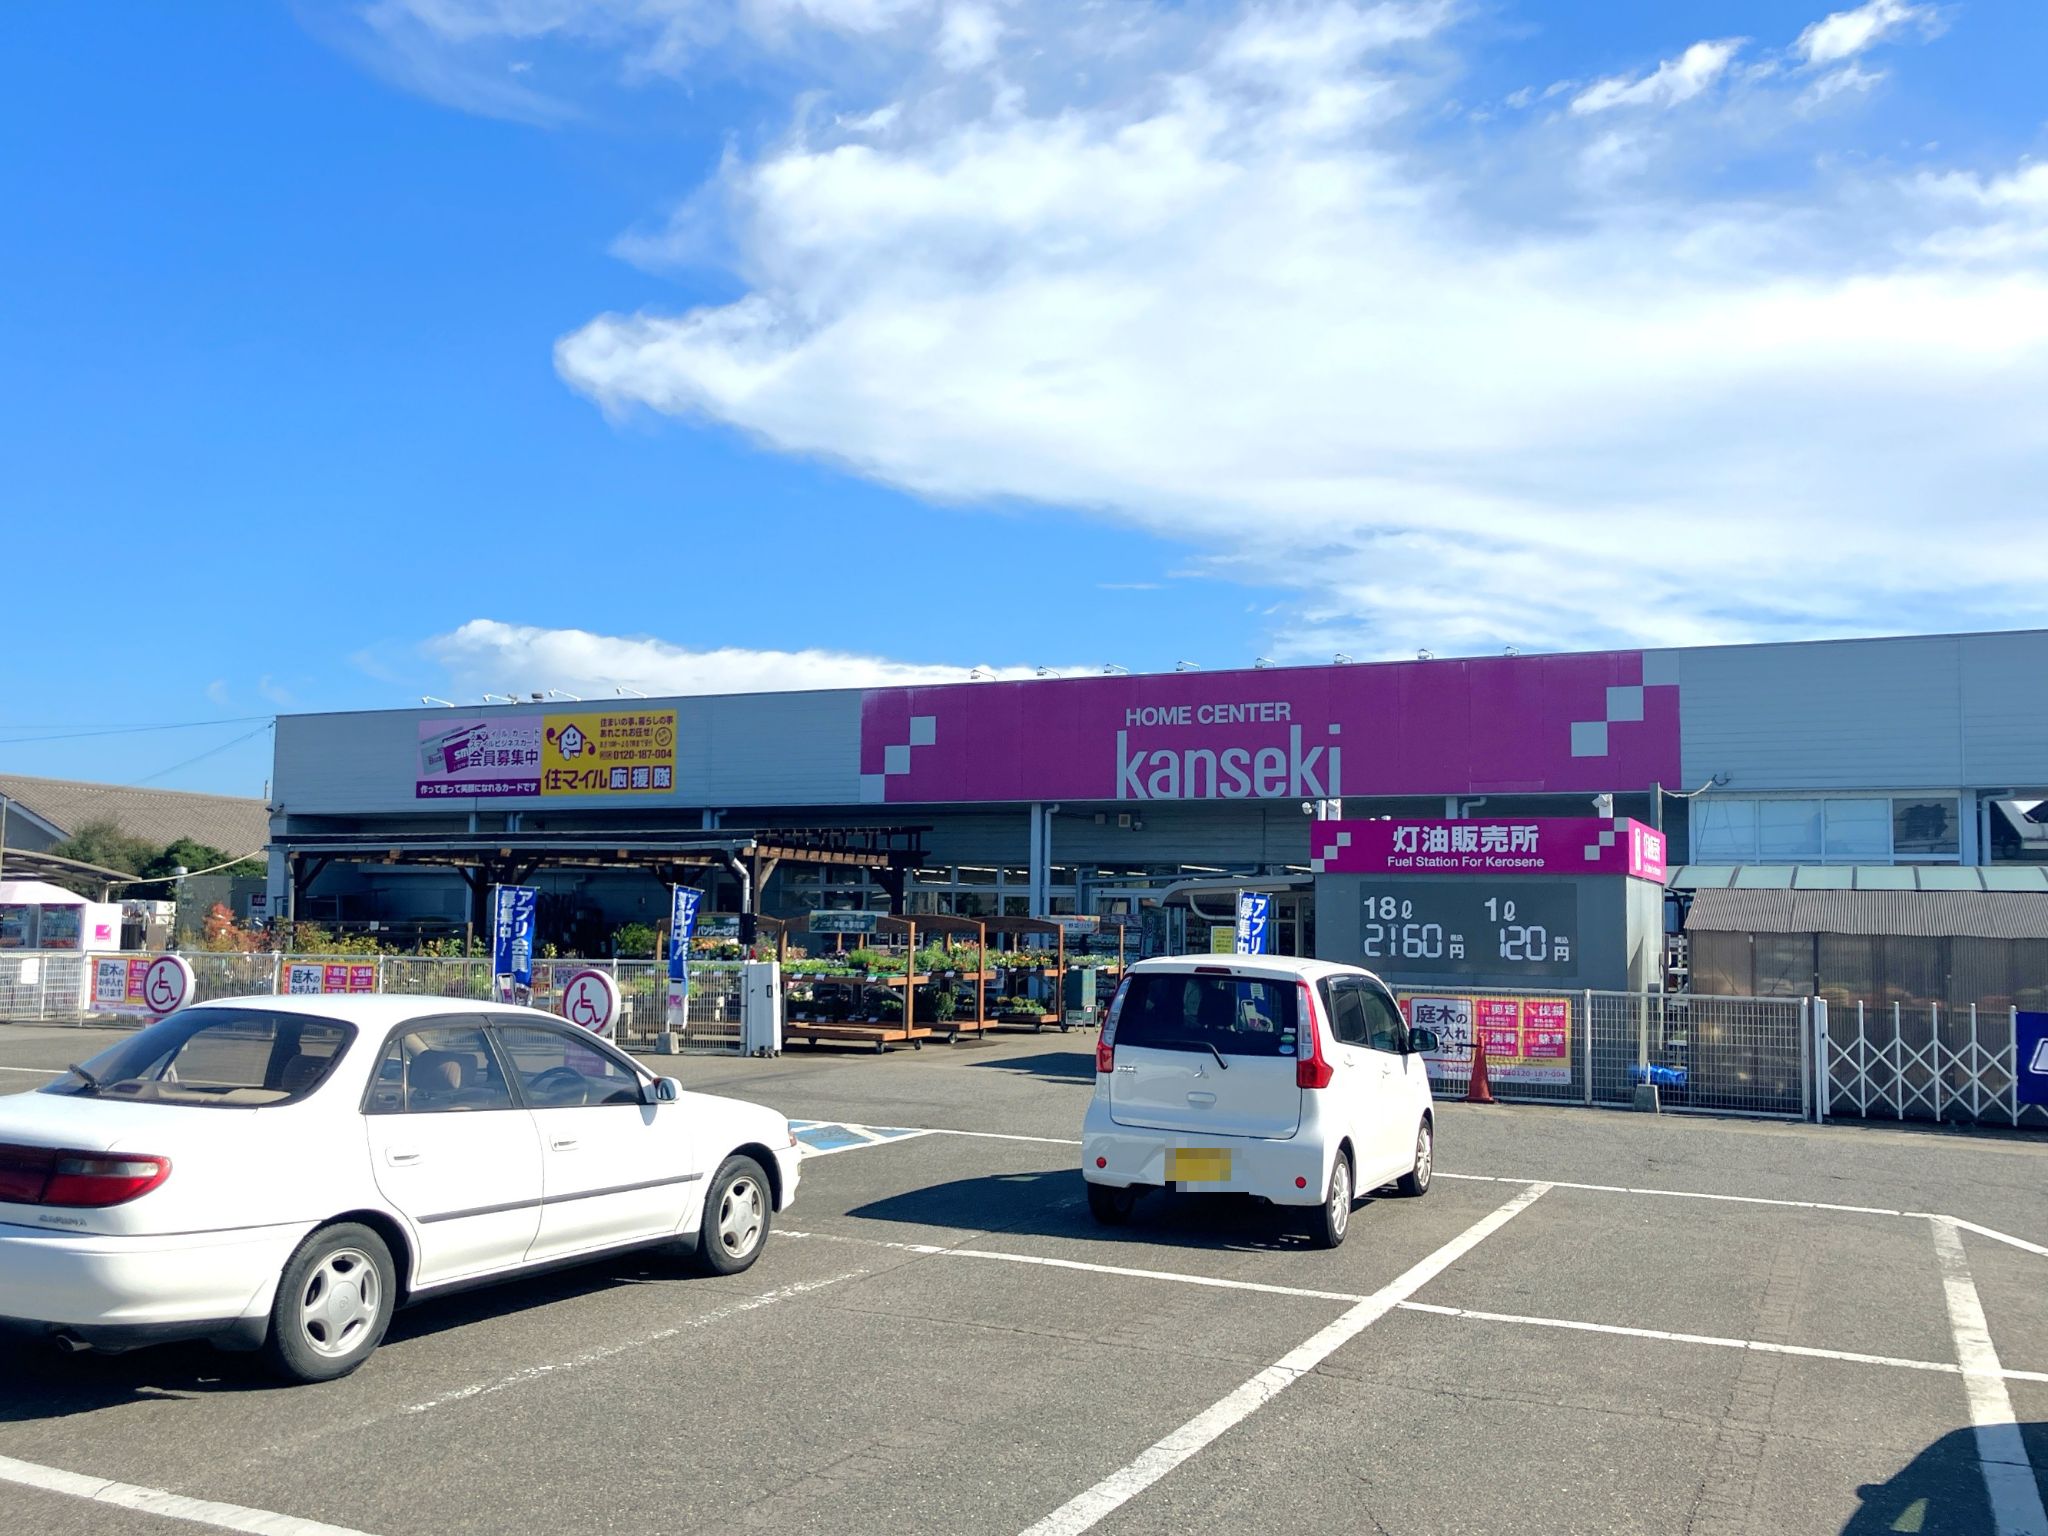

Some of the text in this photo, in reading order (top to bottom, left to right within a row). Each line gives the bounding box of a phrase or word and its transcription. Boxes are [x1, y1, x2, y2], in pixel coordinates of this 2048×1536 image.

[1125, 702, 1291, 726] HOME CENTER
[469, 748, 539, 767] 会員募集中
[613, 749, 672, 760] 0120-187-004
[1116, 724, 1341, 799] kanseki
[1392, 825, 1539, 854] 灯油販売所
[1387, 855, 1545, 868] Fuel Station For Kerosene
[511, 890, 533, 972] アプリ会員
[1364, 924, 1443, 958] 2160
[1499, 925, 1547, 961] 120
[1449, 943, 1465, 959] 円
[1554, 946, 1569, 961] 円
[100, 963, 124, 976] 庭木の
[292, 970, 320, 984] 庭木の
[99, 979, 123, 987] お手入れ
[1416, 1005, 1468, 1024] 庭木の
